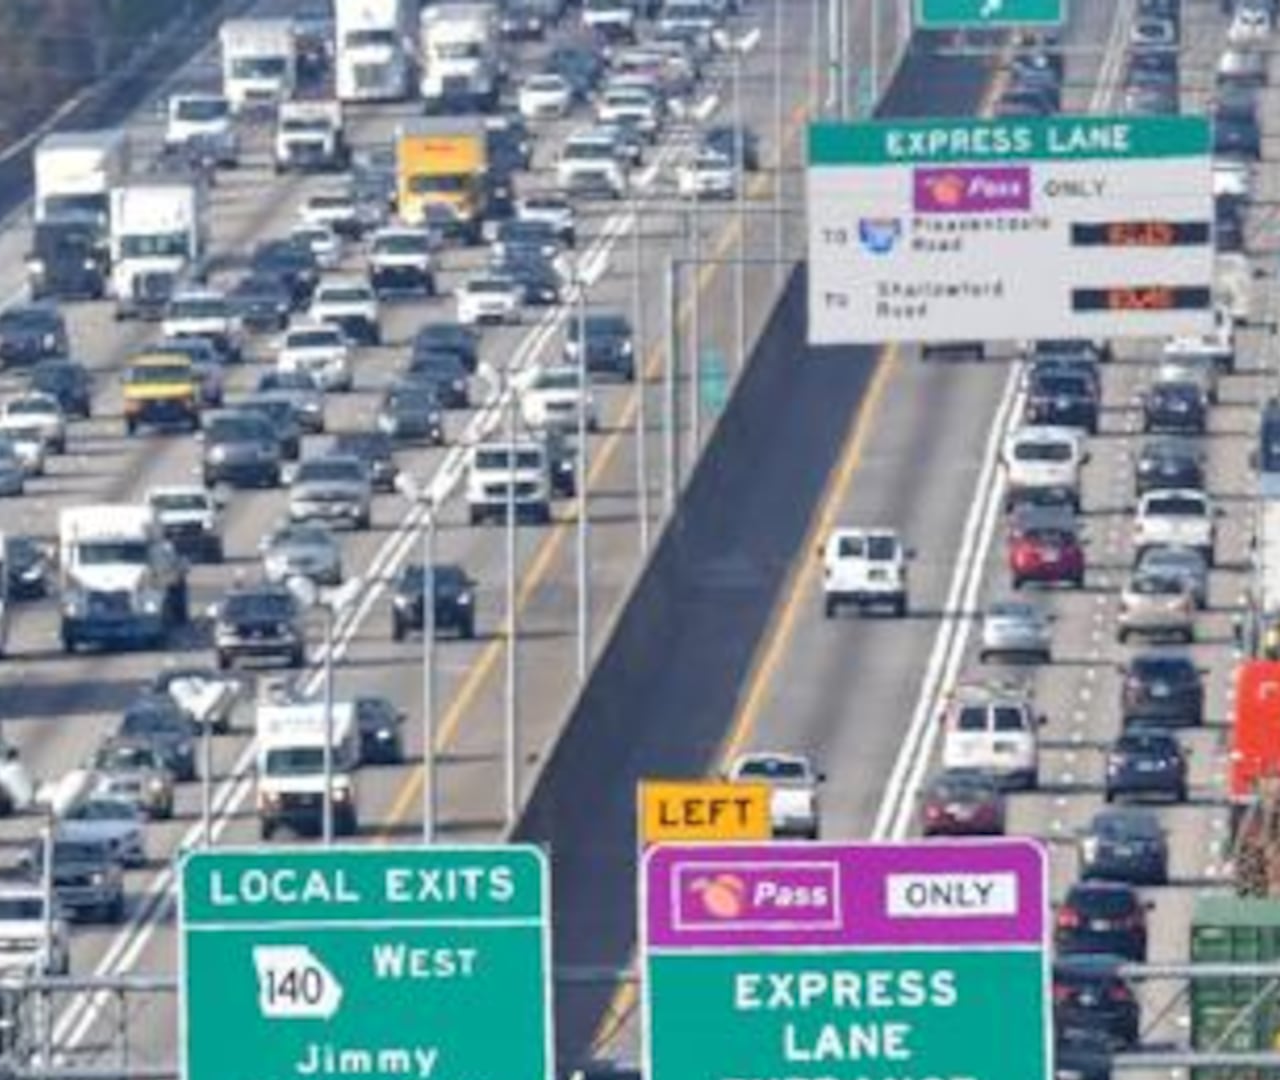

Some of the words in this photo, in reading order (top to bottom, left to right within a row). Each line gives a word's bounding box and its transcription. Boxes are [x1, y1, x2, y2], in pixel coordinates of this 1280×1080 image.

[886, 126, 1032, 157] EXPRESS
[1047, 124, 1131, 153] LANE
[1044, 178, 1105, 198] ONLY
[659, 798, 753, 828] LEFT
[210, 868, 360, 905] LOCAL
[383, 866, 517, 903] EXITS
[753, 881, 829, 908] Pass
[905, 881, 994, 909] ONLY
[372, 943, 477, 979] WEST
[266, 967, 324, 1006] 140
[734, 969, 959, 1011] EXPRESS
[783, 1021, 913, 1063] LANE
[296, 1043, 440, 1079] Jimmy
